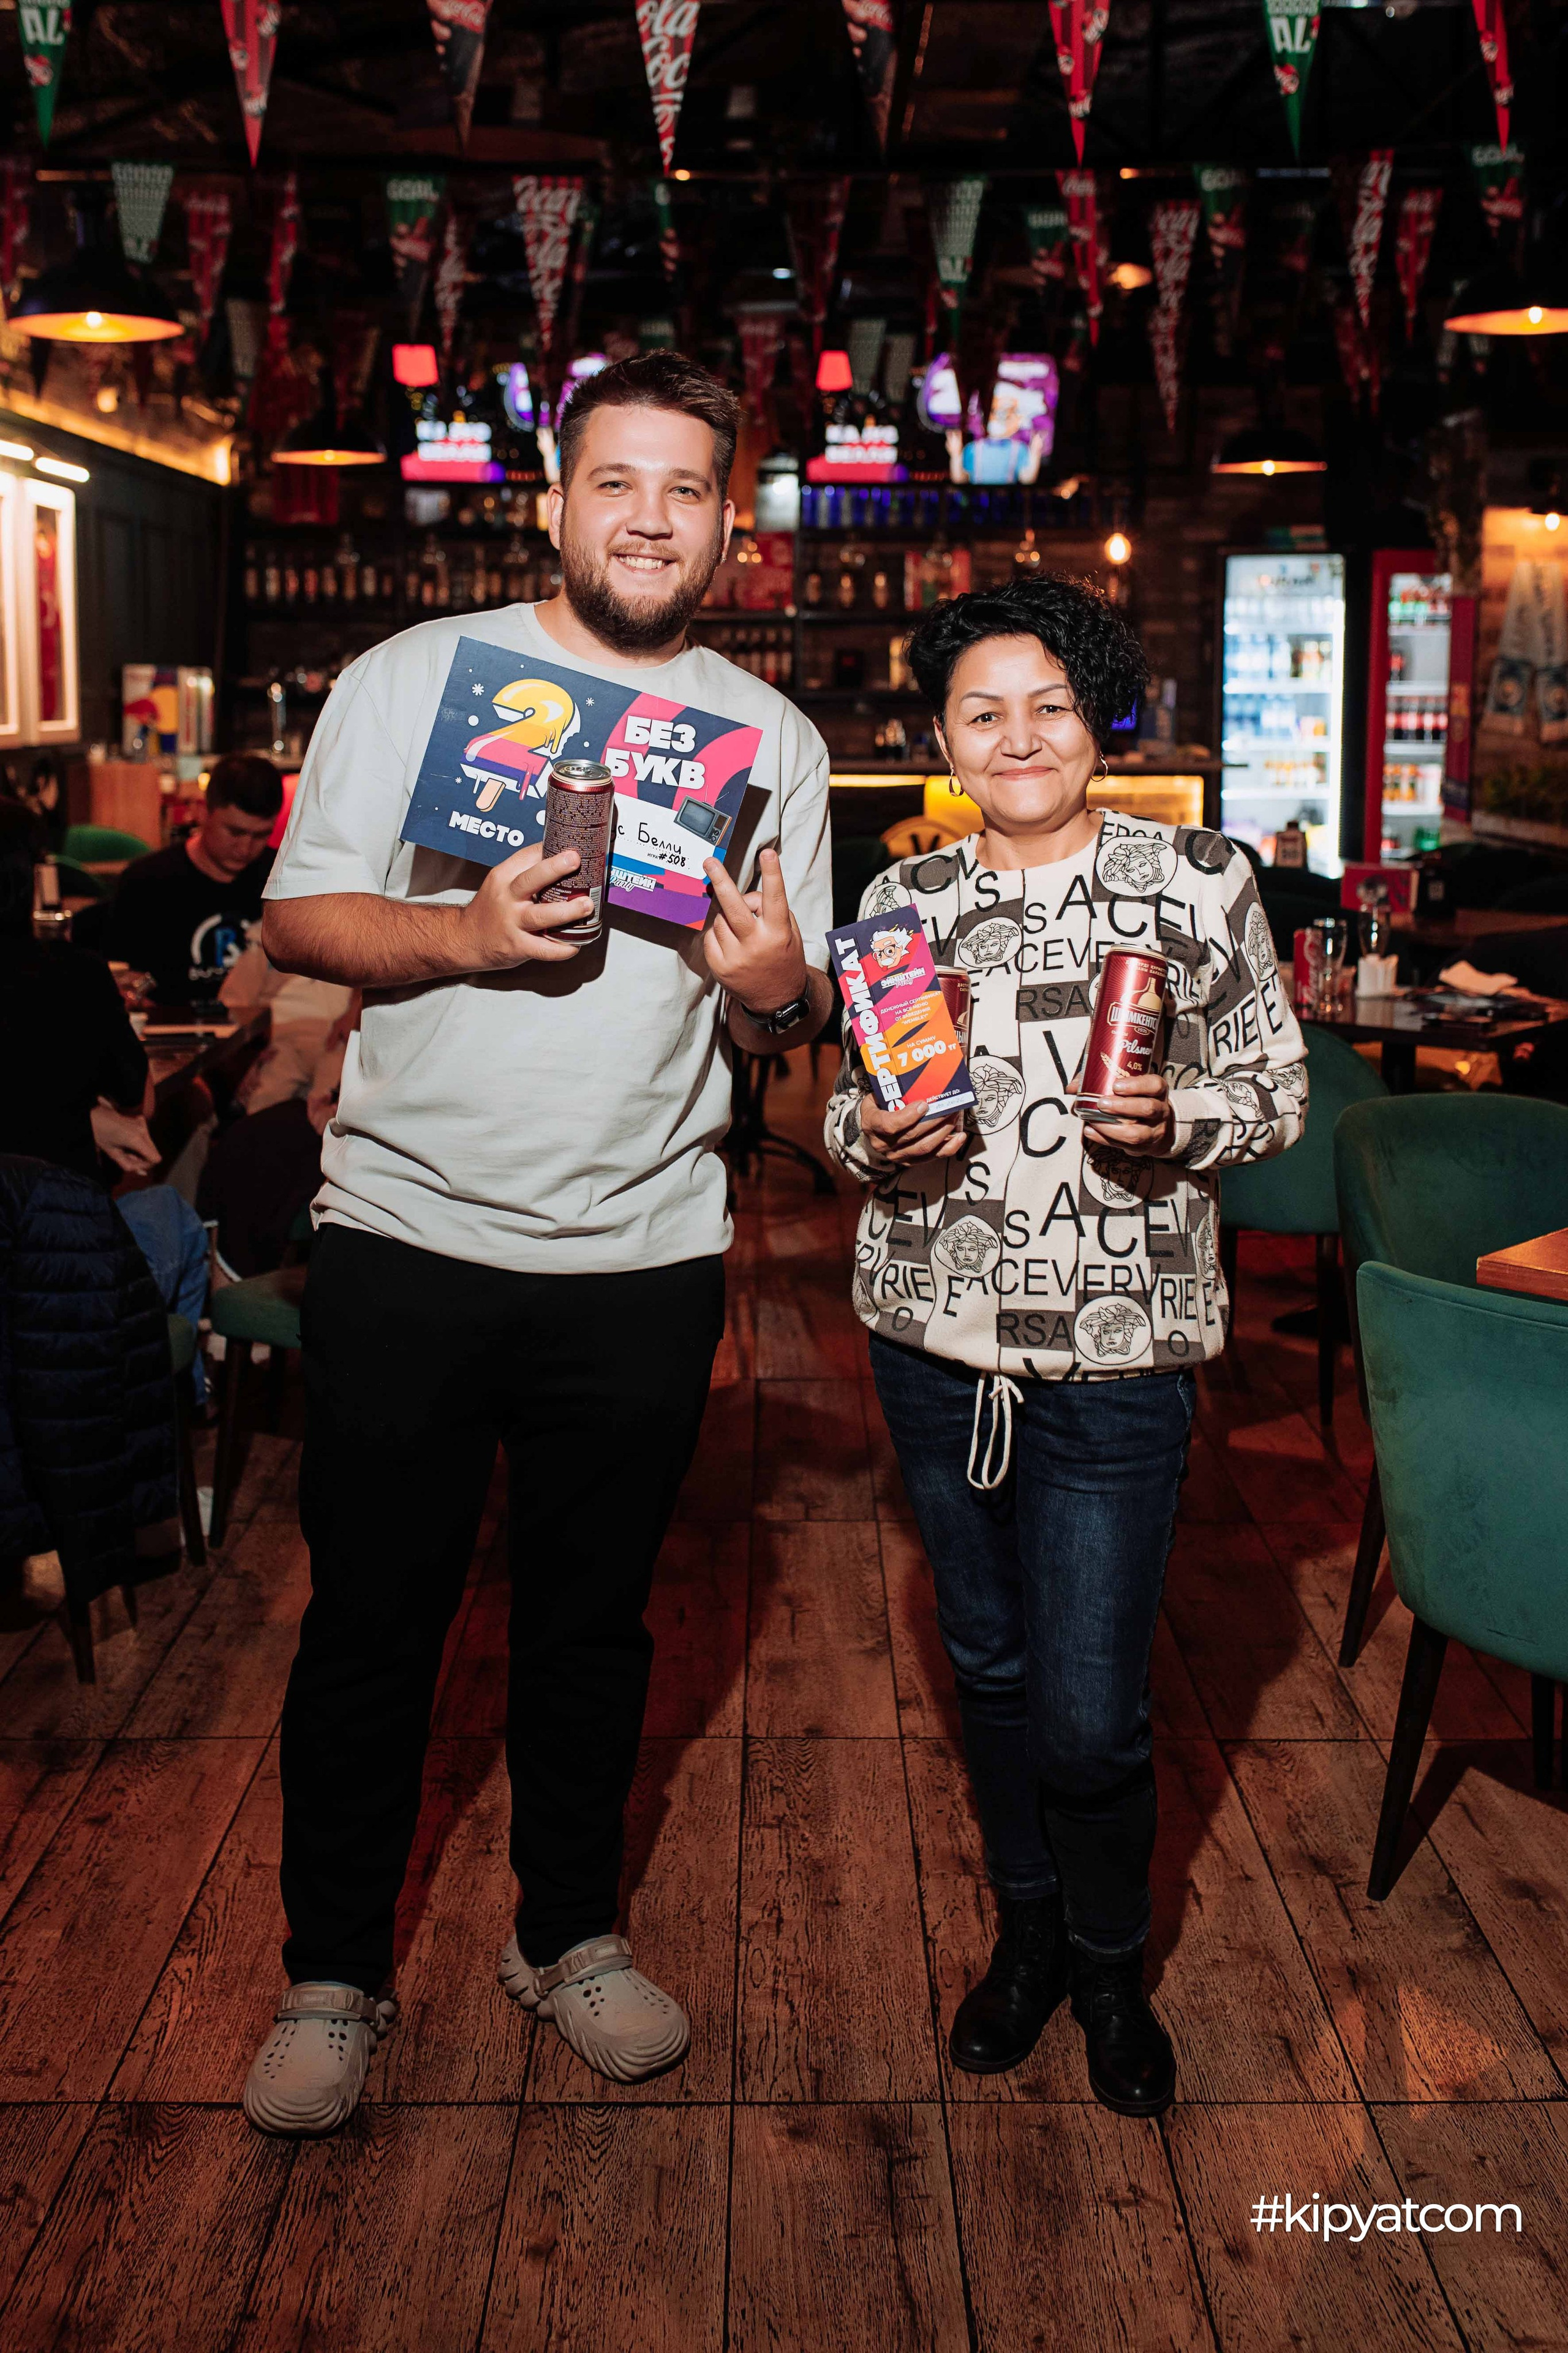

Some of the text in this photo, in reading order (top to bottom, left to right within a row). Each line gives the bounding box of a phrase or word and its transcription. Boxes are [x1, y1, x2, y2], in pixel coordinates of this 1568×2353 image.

[624, 716, 696, 753] БЕЗ
[604, 747, 706, 790] БУКВ
[448, 810, 524, 847] МЕСТО
[638, 822, 682, 855] Белли
[658, 853, 687, 867] #508
[880, 991, 941, 1014] ДЕНЕЖНЫЙ СЕРТИФИКАТ
[902, 1007, 931, 1019] ЗАВЕДЕНИЯ
[916, 1035, 936, 1046] СУММУ
[897, 1052, 908, 1067] 7
[911, 1040, 946, 1062] 000
[1126, 1061, 1142, 1071] 4,0%
[926, 1090, 952, 1103] ДЕЙСТВУЕТ
[996, 1313, 1073, 1348] RSA
